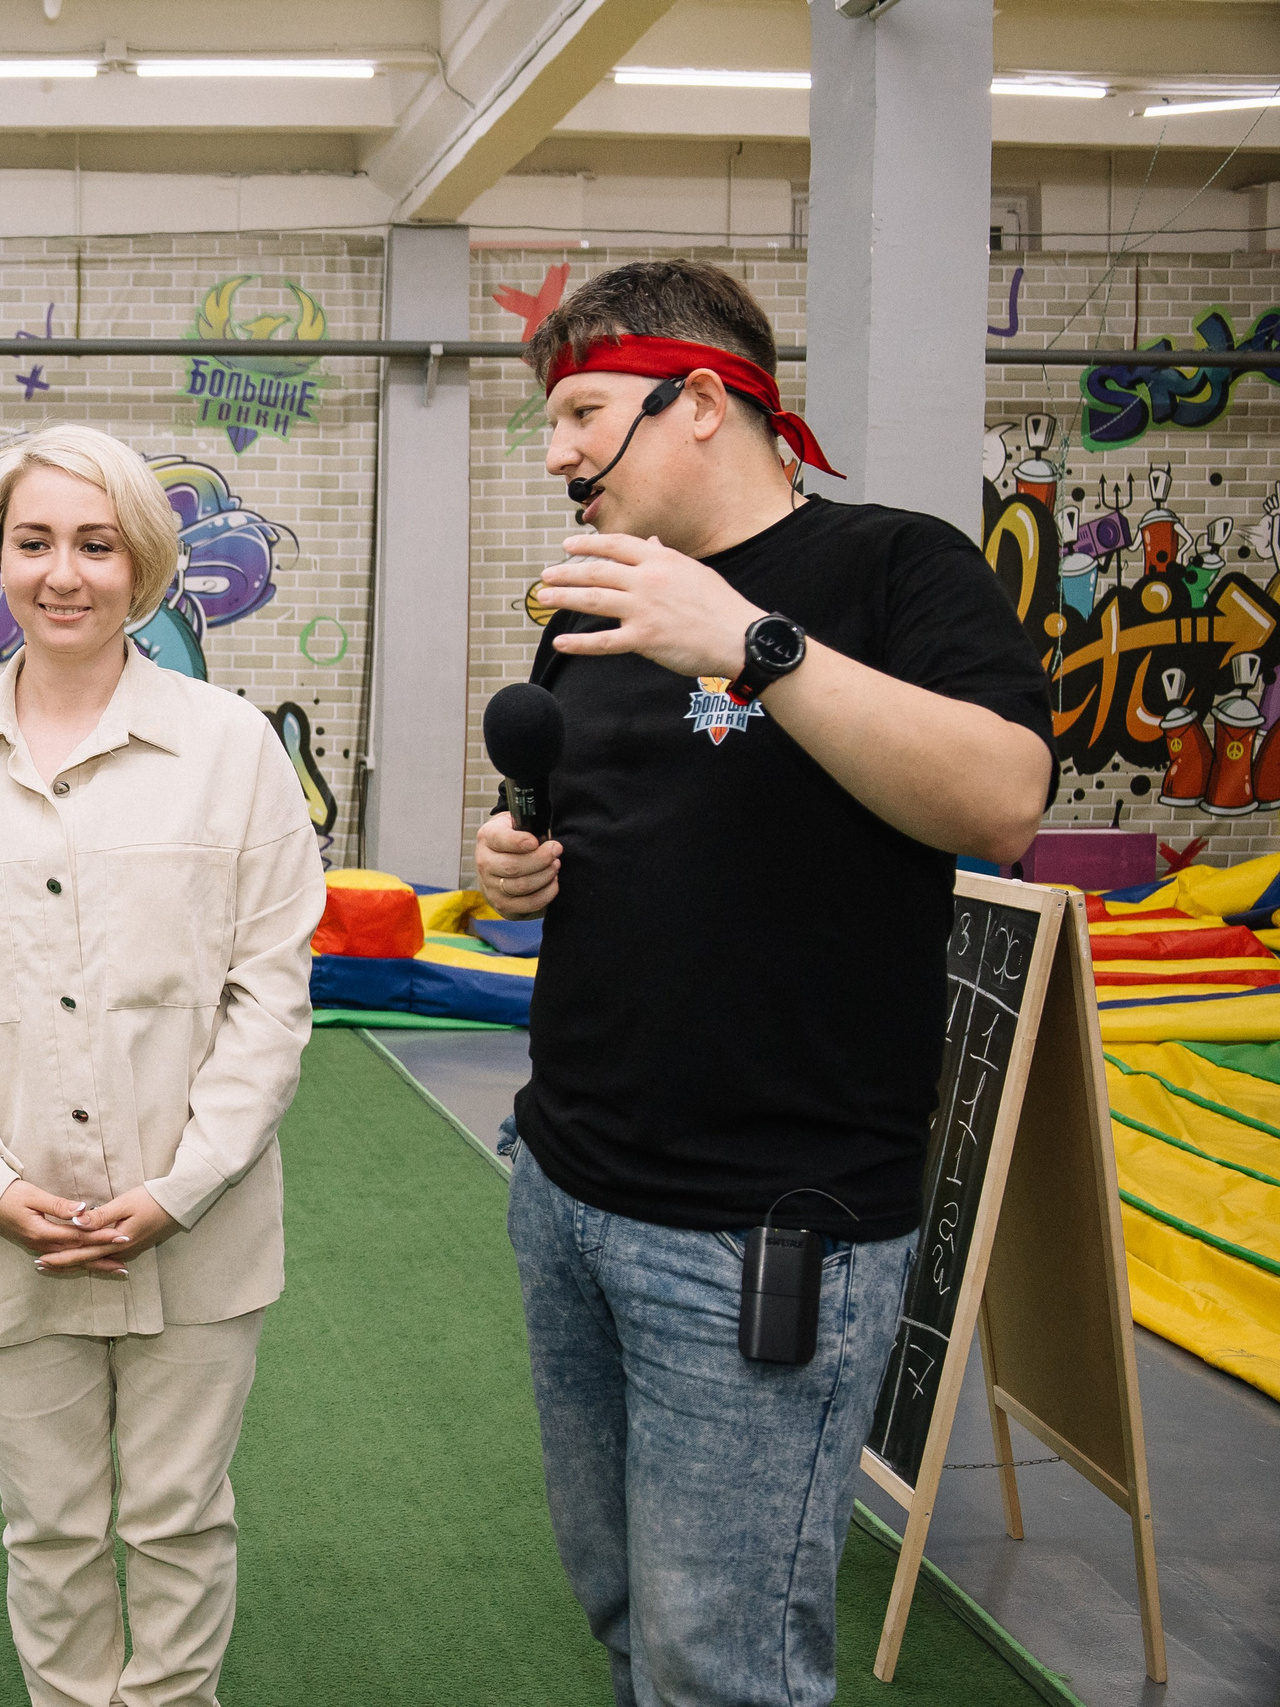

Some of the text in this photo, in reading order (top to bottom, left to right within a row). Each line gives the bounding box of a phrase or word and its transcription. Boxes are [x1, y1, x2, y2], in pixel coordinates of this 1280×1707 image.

[187, 358, 317, 418] БОЛЬШИЕ
[201, 399, 290, 437] ГОНКИ
[696, 713, 747, 729] ГОНКИ
